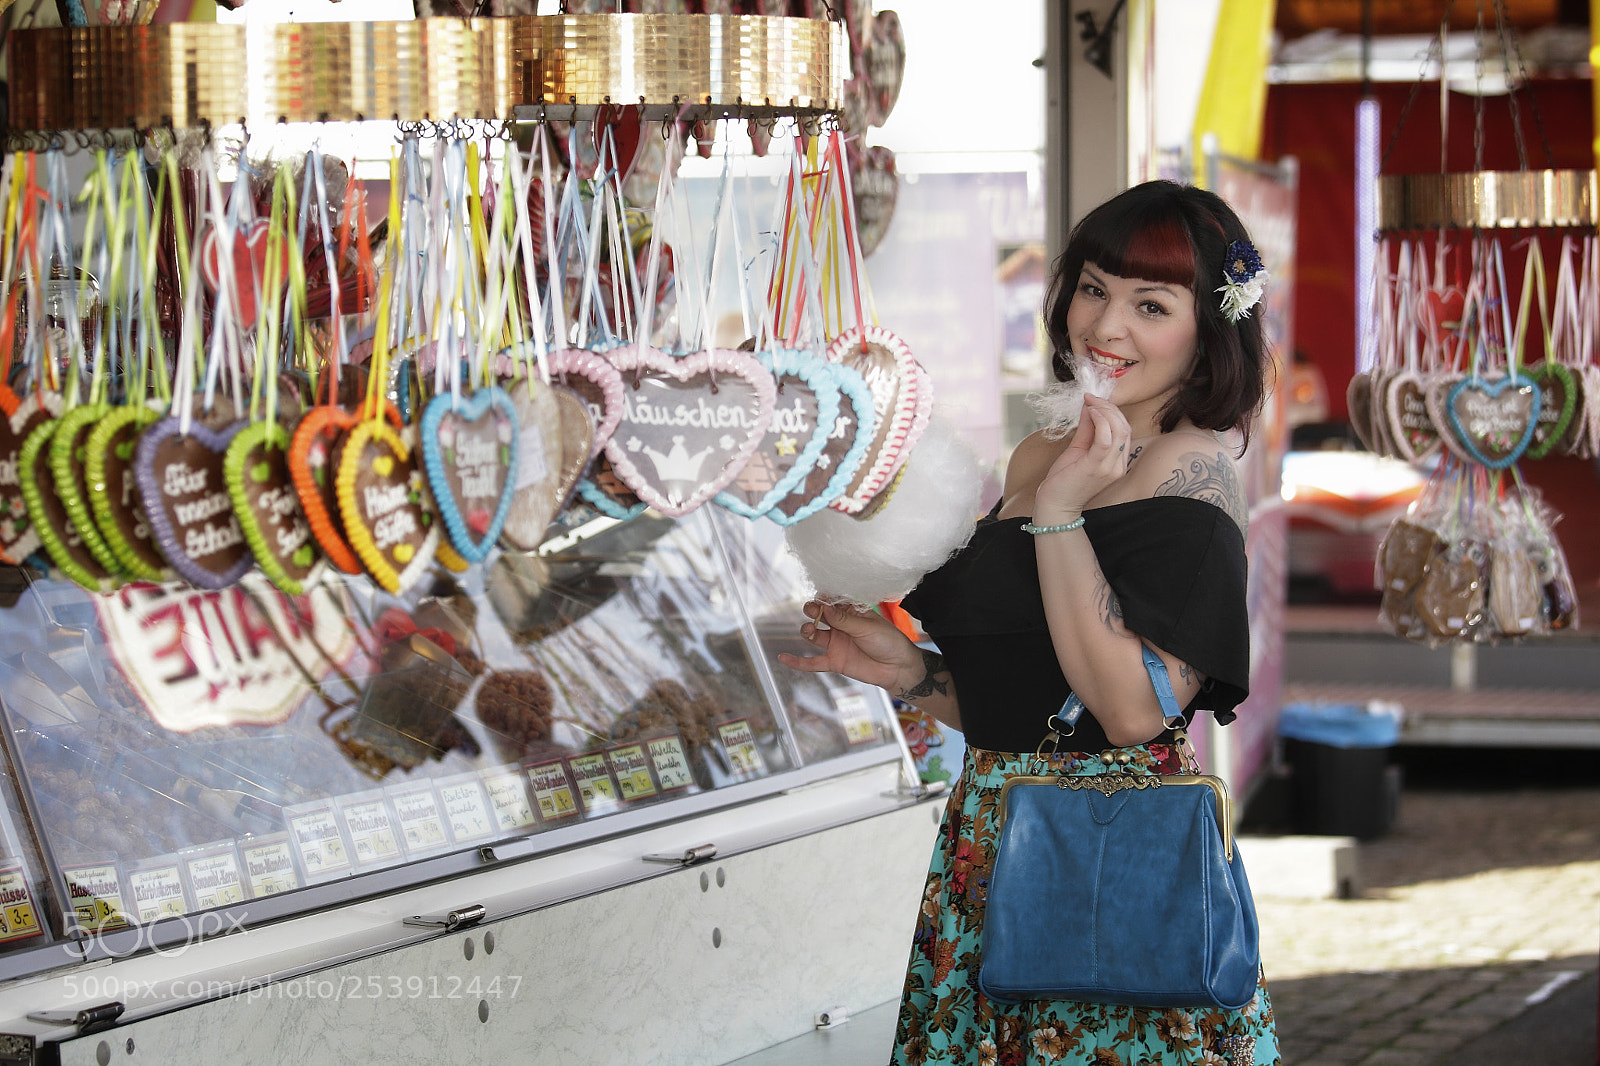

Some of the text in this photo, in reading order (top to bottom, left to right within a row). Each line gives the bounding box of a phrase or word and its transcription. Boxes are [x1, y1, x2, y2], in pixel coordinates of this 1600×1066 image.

[163, 462, 208, 497] Für
[723, 730, 752, 748] Mandeln
[651, 741, 680, 758] Nutella
[348, 815, 389, 833] Walnüsse
[248, 855, 293, 877] Rum-Mandeln
[69, 879, 119, 899] Haselnüsse
[135, 881, 182, 902] Kürbiskerne
